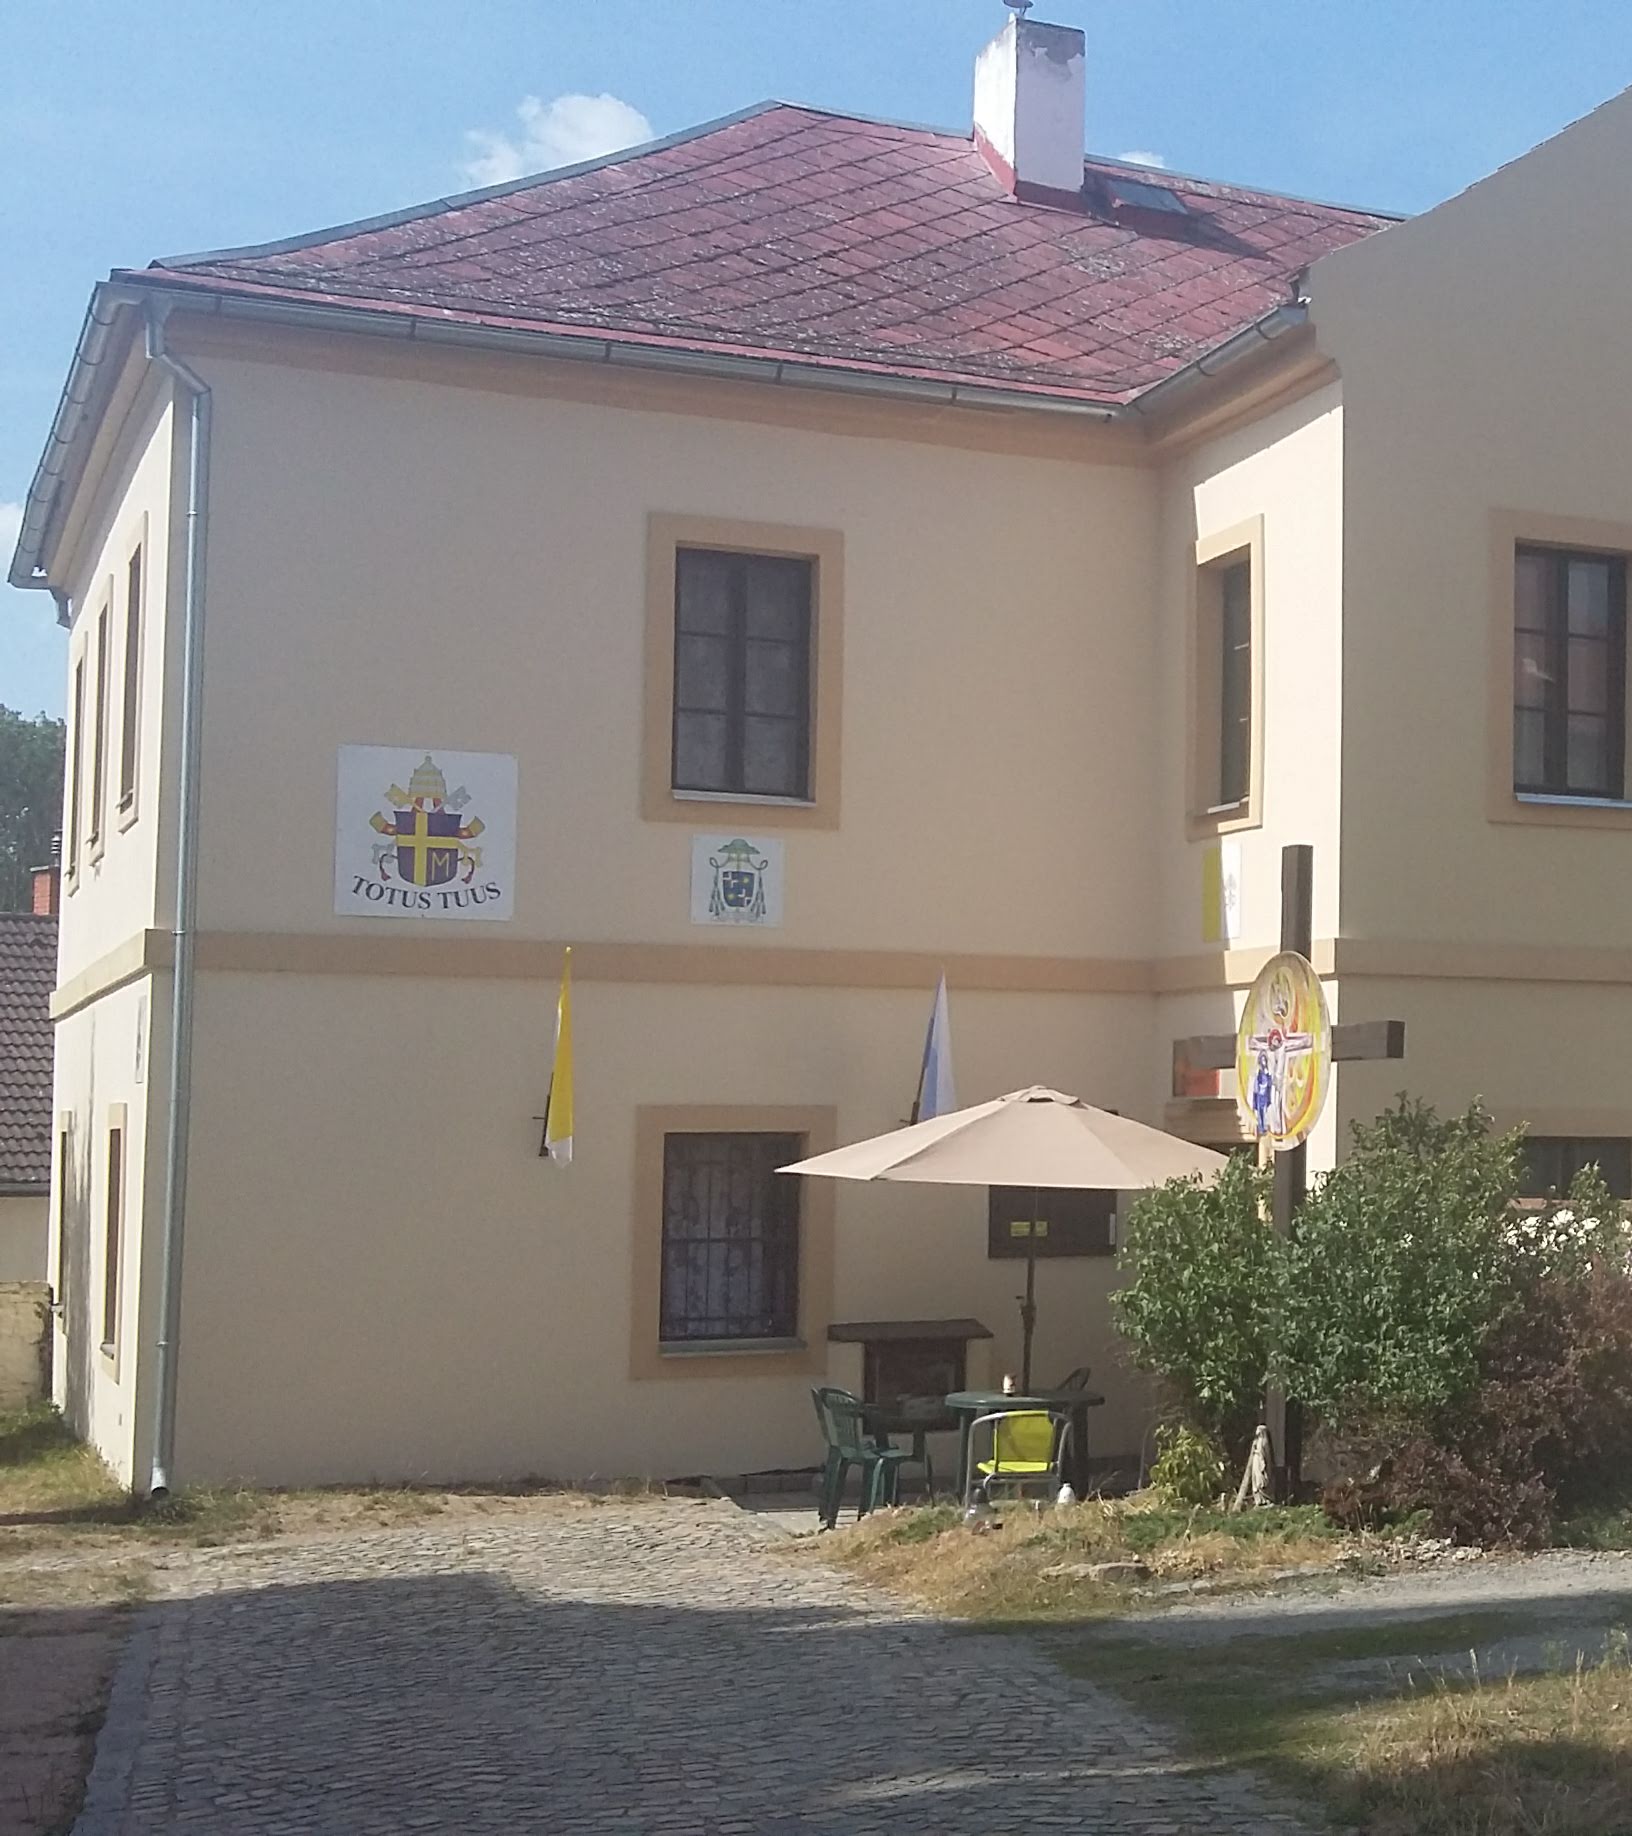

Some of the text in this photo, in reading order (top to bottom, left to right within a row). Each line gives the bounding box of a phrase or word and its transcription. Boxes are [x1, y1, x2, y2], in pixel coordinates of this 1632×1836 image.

[431, 851, 450, 881] M
[352, 875, 501, 910] TOTUS TUUS
